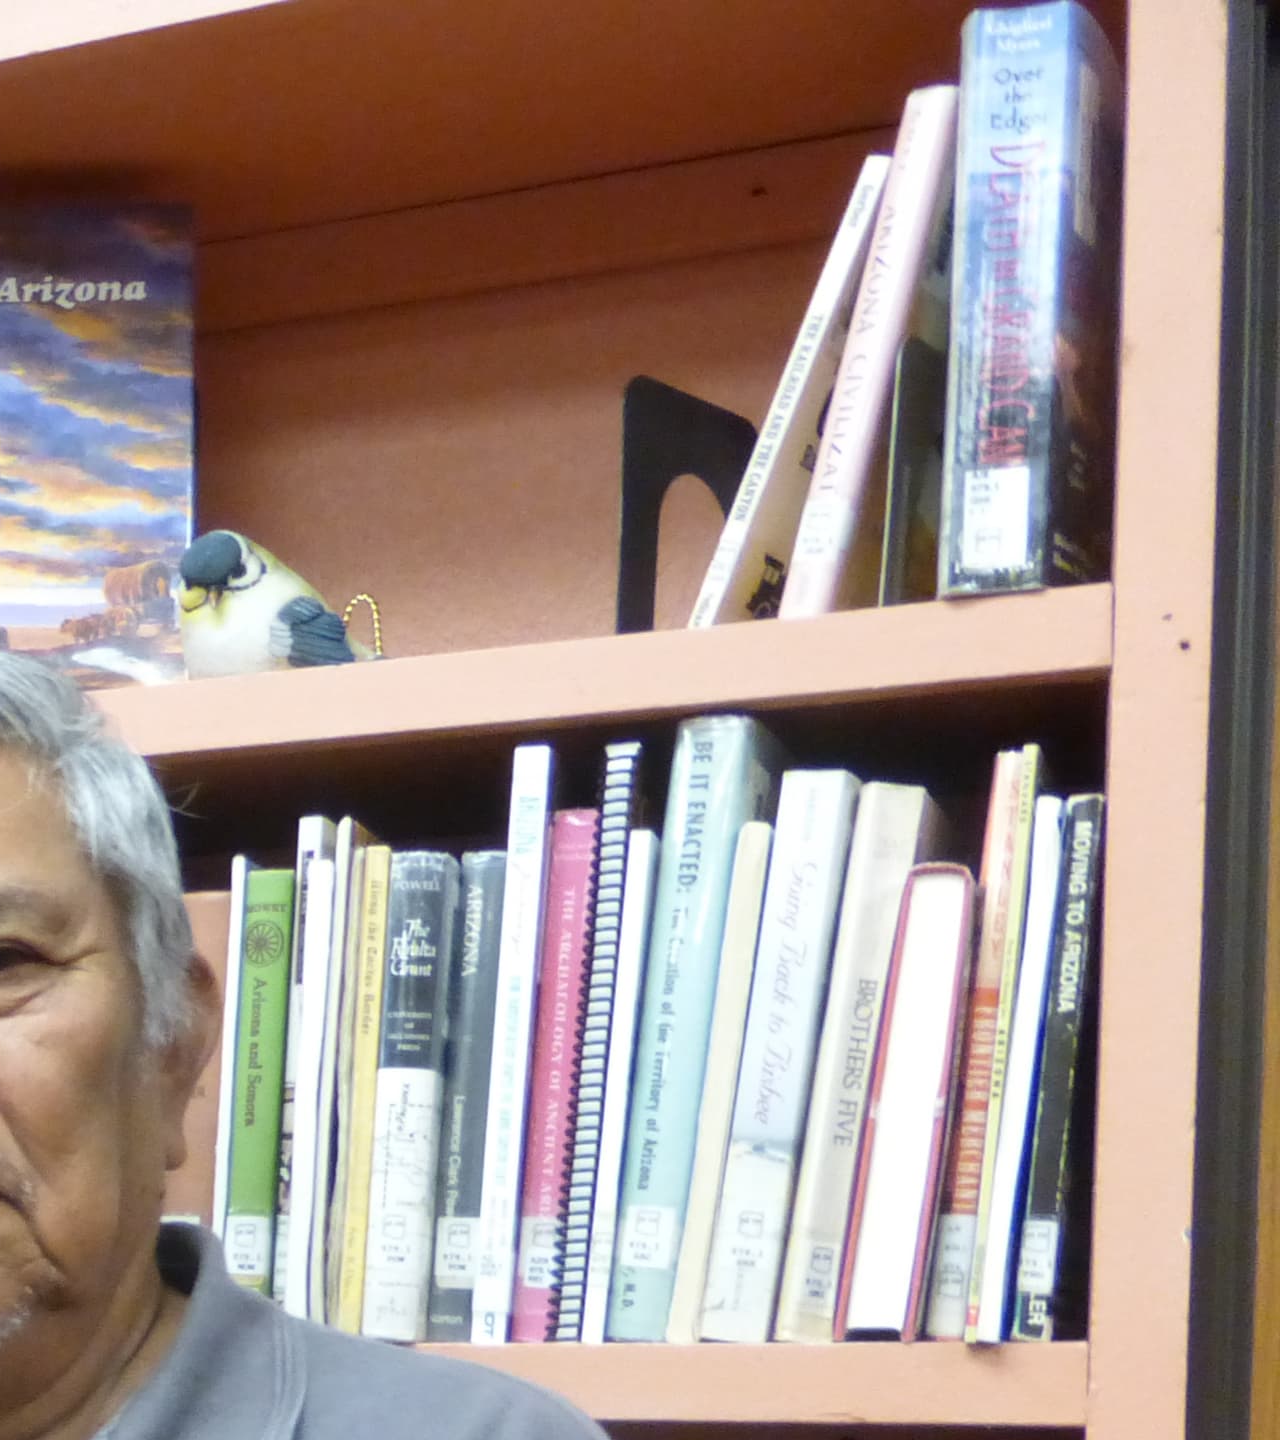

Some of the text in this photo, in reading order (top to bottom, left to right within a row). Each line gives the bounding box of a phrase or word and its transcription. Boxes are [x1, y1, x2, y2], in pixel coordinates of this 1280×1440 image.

[992, 67, 1043, 85] Over
[856, 204, 900, 335] ARIZONA
[733, 316, 825, 521] THE RAILROAD AND THE CANYON
[404, 917, 432, 940] The
[460, 884, 484, 977] ARIZONA
[780, 860, 820, 931] Going
[1057, 820, 1095, 1013] MOVING TO ARIZONA
[389, 959, 432, 977] Grant
[638, 741, 713, 1191] BE IT ENACTED: of the Territory of Arizona
[771, 937, 808, 1004] Back
[243, 976, 269, 1129] Arizona and Sonora
[542, 888, 577, 1177] THE ARCHAEOLOGY ANCIENT
[769, 1015, 789, 1034] to
[833, 978, 879, 1147] BROTHERS FIVE
[754, 1039, 793, 1128] Bisbee
[448, 1156, 464, 1185] Clark
